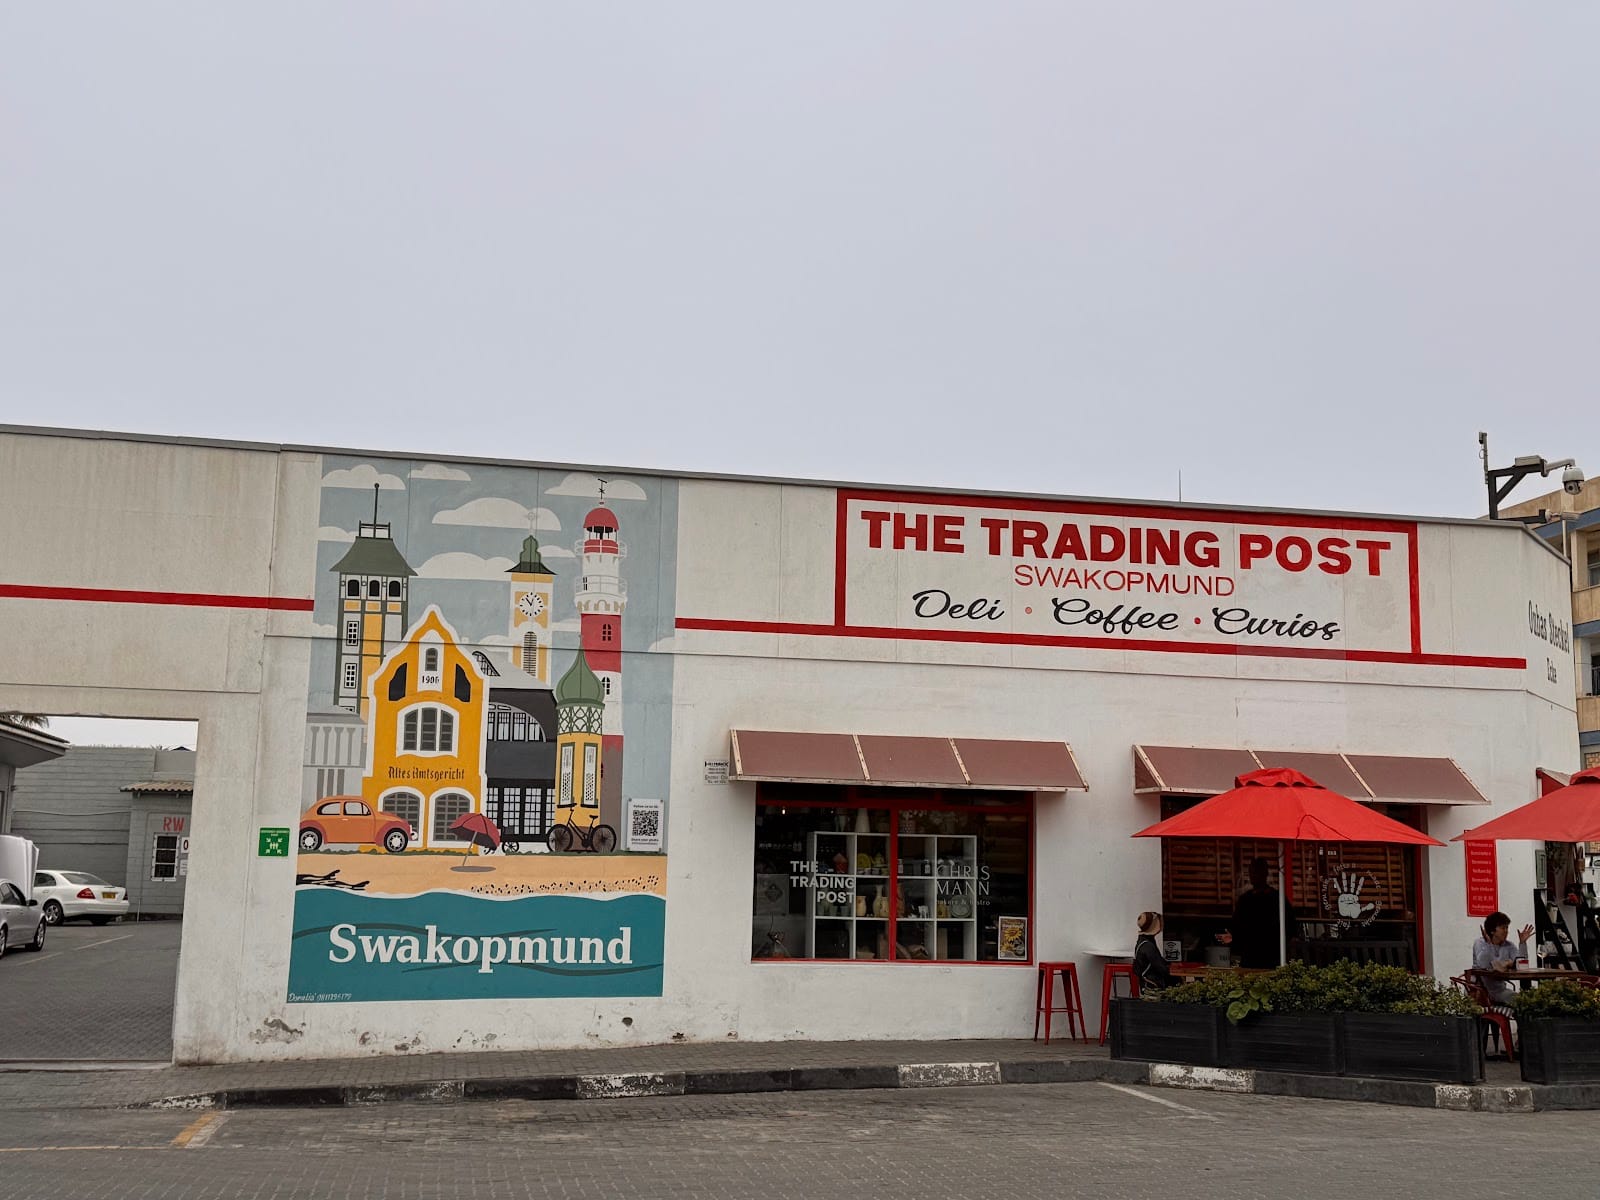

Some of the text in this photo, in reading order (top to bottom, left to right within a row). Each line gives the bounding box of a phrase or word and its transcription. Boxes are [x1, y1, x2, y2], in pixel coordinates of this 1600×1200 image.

[861, 511, 1392, 577] THE TRADING POST
[1014, 565, 1236, 598] SWAKOPMUND
[912, 589, 1341, 642] Deli Coffee Curios
[388, 766, 465, 782] Altes Amtsgericht
[790, 860, 820, 874] THE
[936, 865, 991, 881] CHRIS
[790, 876, 856, 889] TRADING
[936, 881, 990, 896] MANN
[816, 891, 856, 904] POST
[328, 923, 633, 974] Swakopmund
